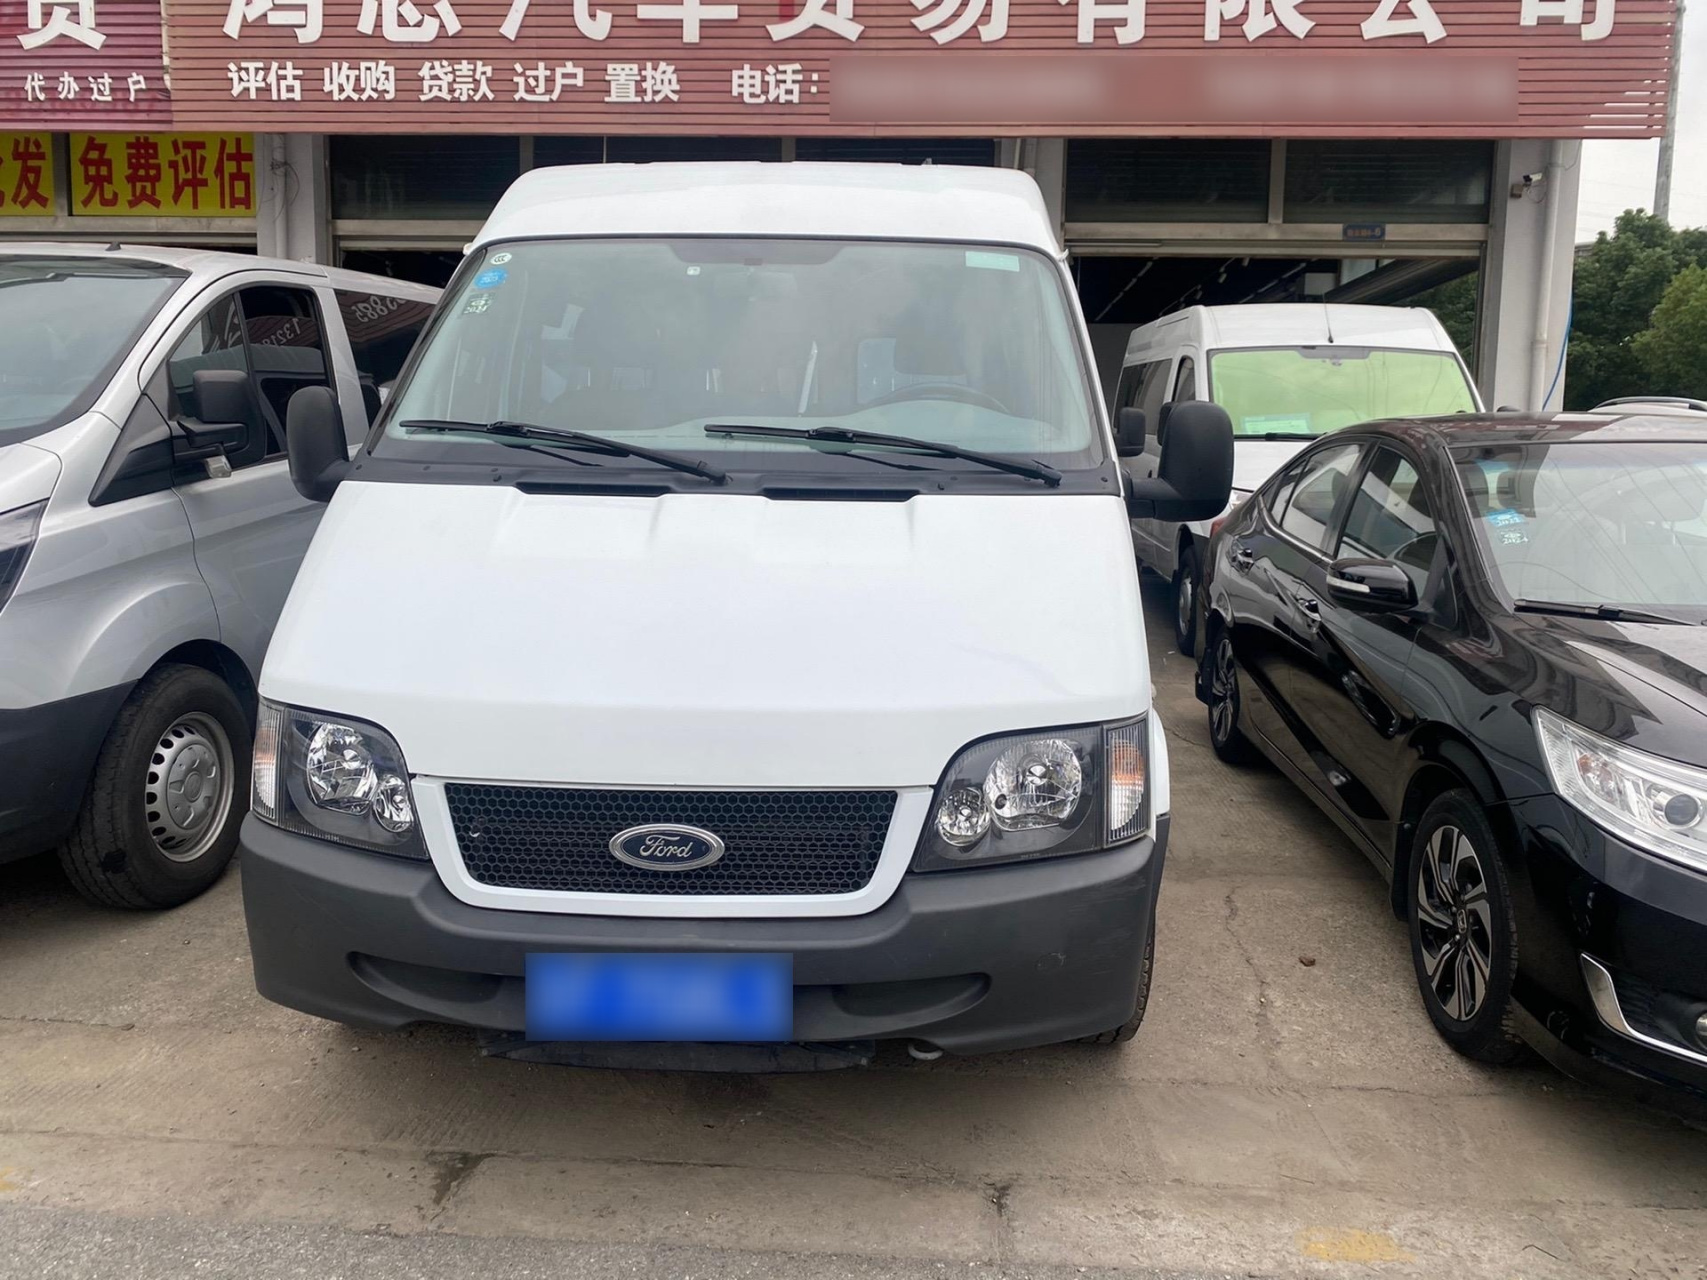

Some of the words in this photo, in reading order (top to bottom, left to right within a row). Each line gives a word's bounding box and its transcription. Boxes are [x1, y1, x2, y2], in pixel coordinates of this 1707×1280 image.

[24, 71, 147, 102] 代办过户
[227, 60, 304, 101] 评估
[323, 60, 396, 102] 收购
[417, 59, 495, 102] 贷款
[513, 61, 584, 102] 过户
[604, 61, 680, 102] 置换
[0, 137, 49, 210] 发
[79, 136, 254, 210] 免费评估
[640, 834, 693, 858] Ford
